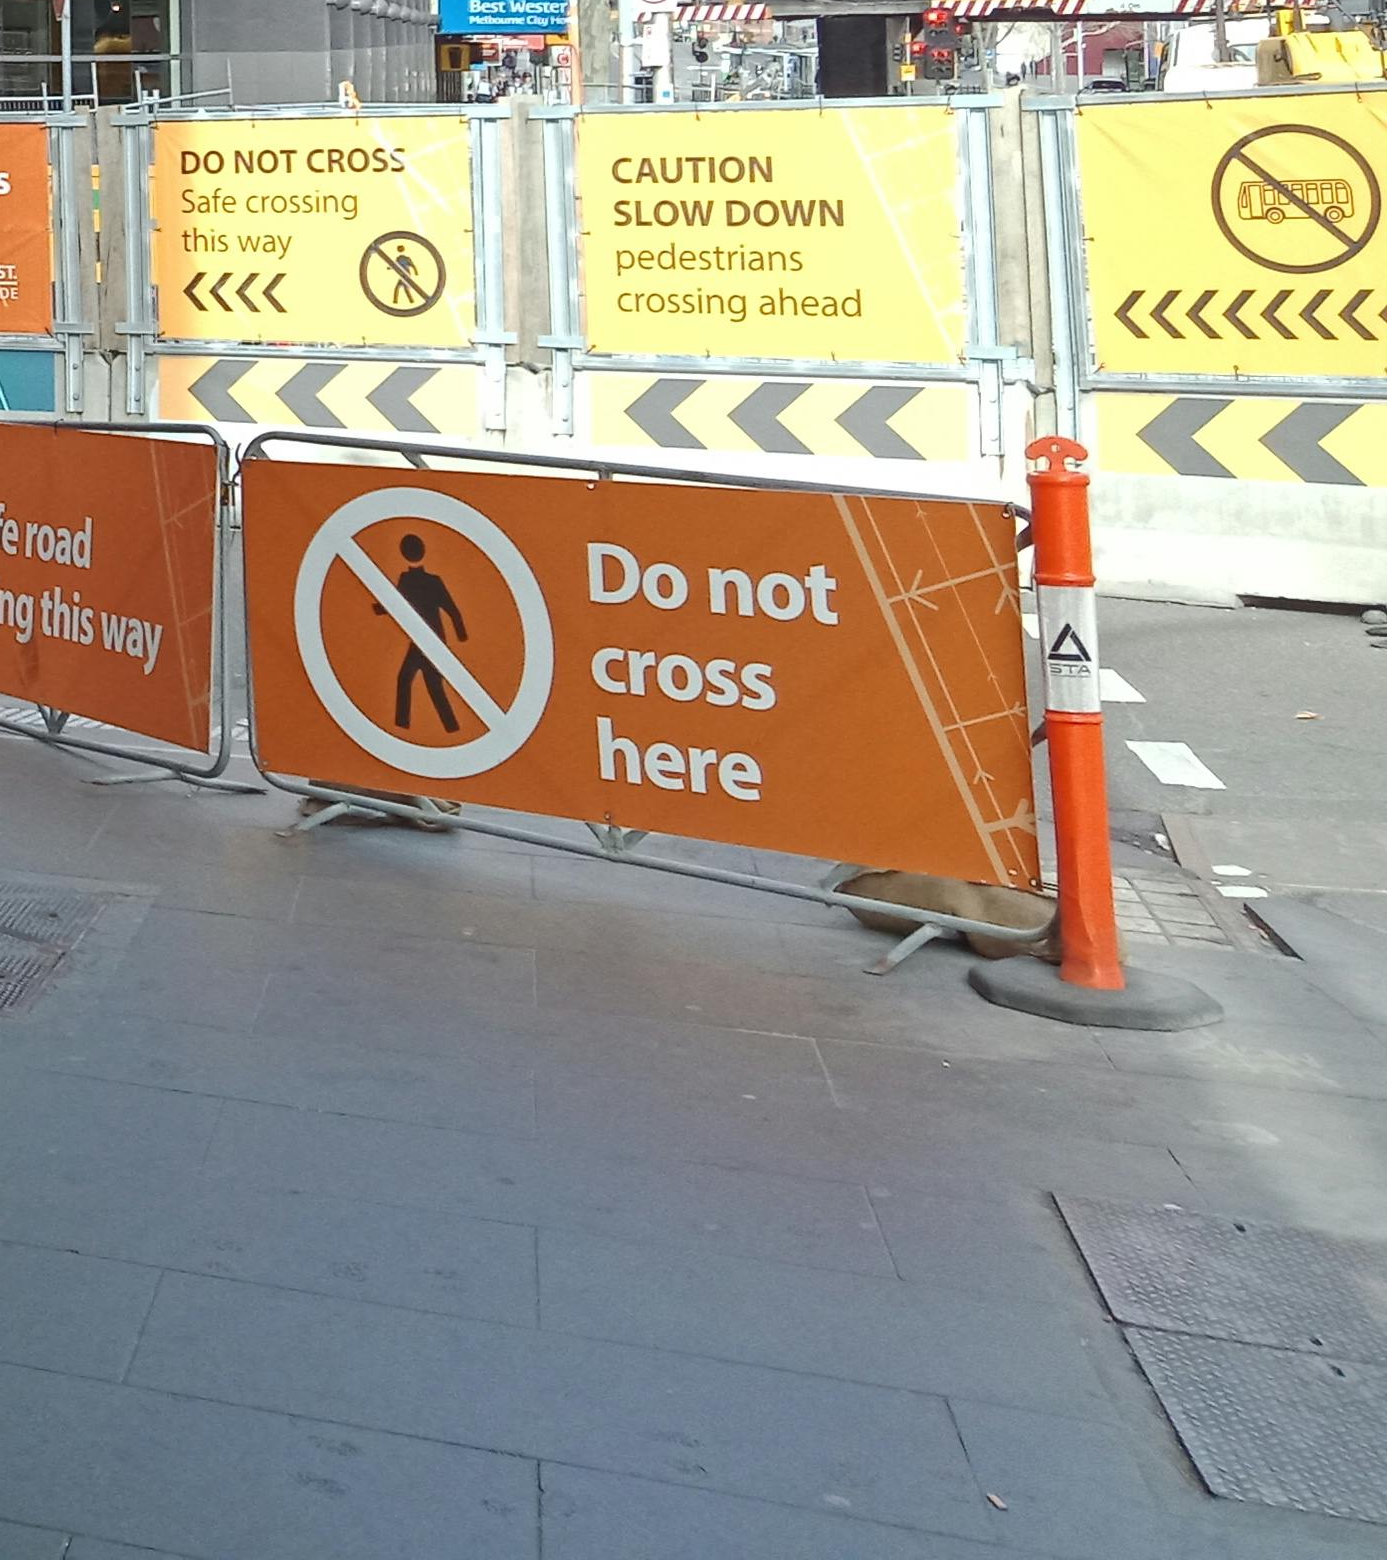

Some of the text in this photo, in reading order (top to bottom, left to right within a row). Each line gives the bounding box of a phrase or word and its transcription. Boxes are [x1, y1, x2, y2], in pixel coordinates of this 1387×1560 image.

[468, 16, 525, 25] Melbourne
[526, 15, 548, 27] City
[469, 0, 506, 13] Best
[180, 146, 407, 175] DO NOT CROSS
[611, 155, 774, 186] CAUTION
[180, 187, 359, 221] Safe crossing
[613, 197, 846, 228] SLOW DOWN
[181, 226, 292, 261] this way
[614, 241, 804, 278] pedestrians
[617, 287, 863, 322] crossing ahead
[25, 517, 93, 569] road
[587, 542, 839, 625] Do not
[40, 586, 95, 646] this
[100, 611, 163, 676] way
[591, 646, 777, 711] cross
[1050, 663, 1091, 674] STA
[596, 716, 762, 801] here
